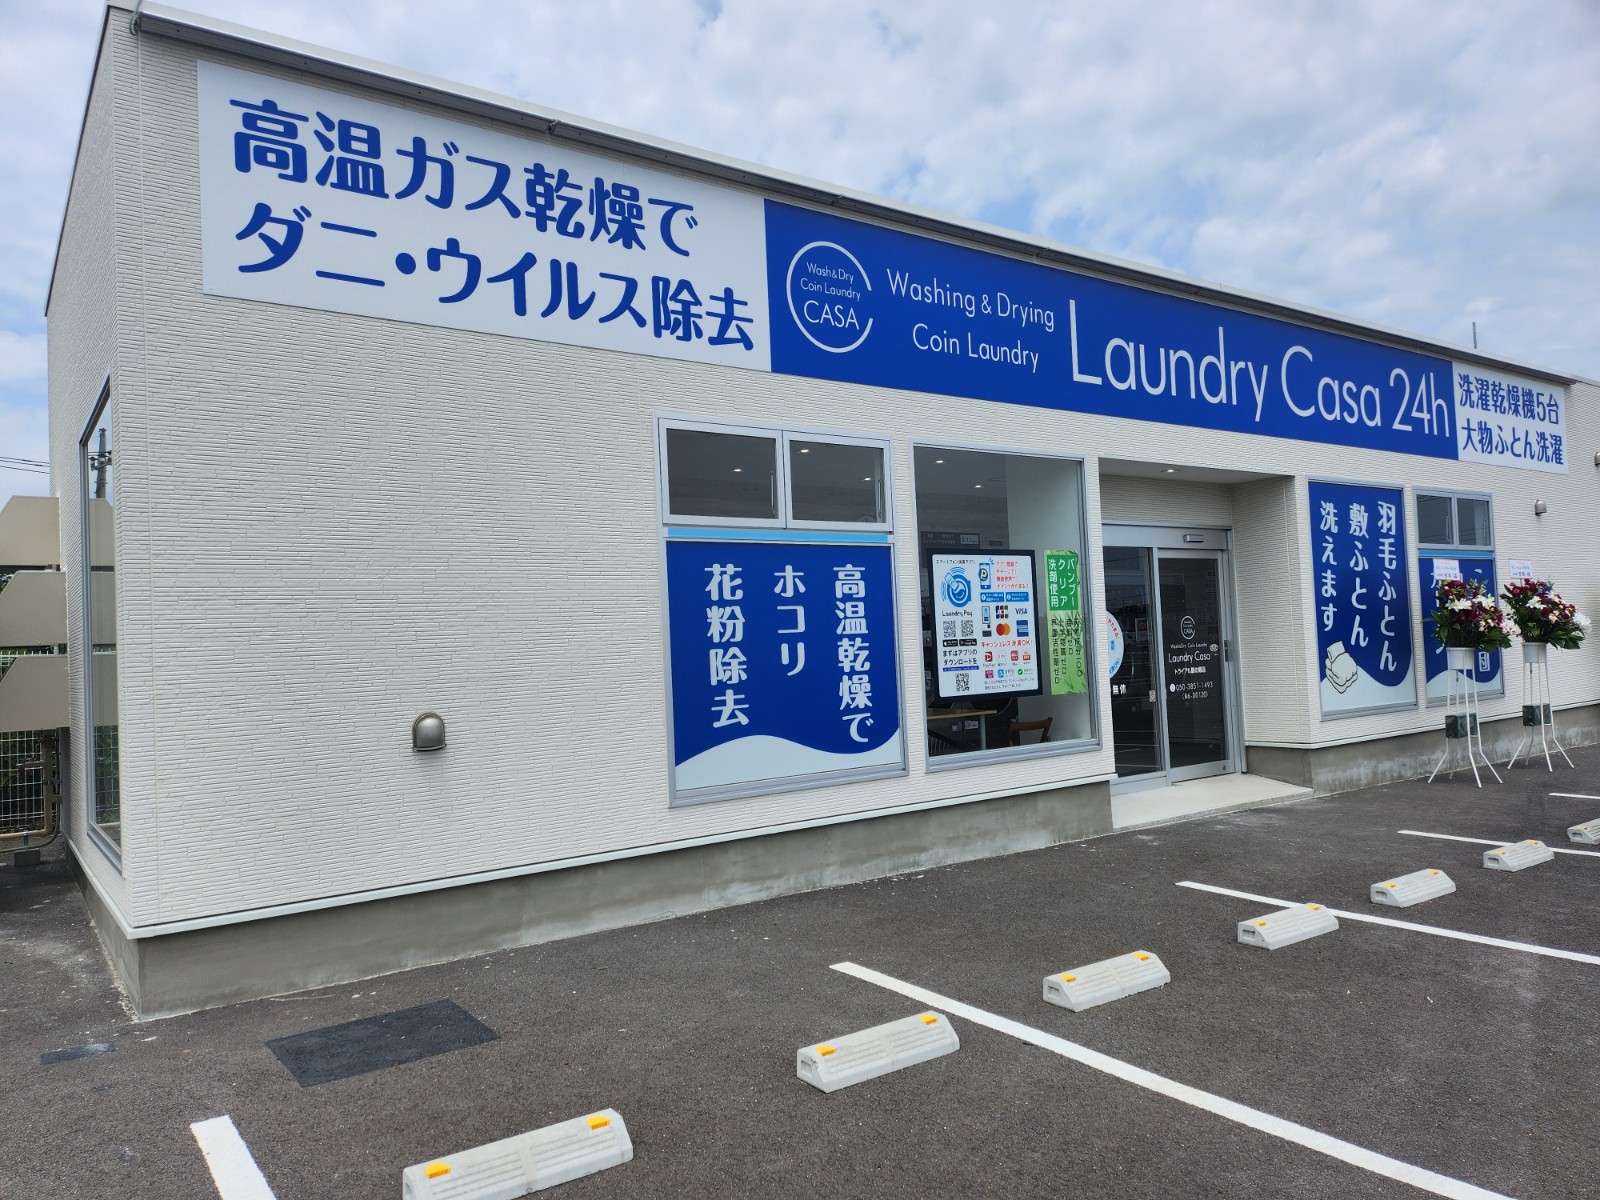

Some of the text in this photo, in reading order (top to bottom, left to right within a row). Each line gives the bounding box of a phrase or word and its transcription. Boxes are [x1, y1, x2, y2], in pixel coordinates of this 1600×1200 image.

[229, 99, 698, 257] 高温ガス乾燥で
[236, 202, 754, 351] ダニ・ウイルス除去
[800, 277, 861, 302] Coin Laundry
[806, 261, 854, 285] Wash&Dry
[803, 300, 860, 330] CASA
[886, 268, 975, 318] Washing
[997, 292, 1055, 332] Drying
[912, 323, 1039, 373] Coin Laundry
[1069, 299, 1450, 438] Laundry Casa 24h
[1458, 373, 1559, 425] 洗濯乾燥機5台
[1461, 418, 1564, 465] 大物ふとん洗濯
[1048, 558, 1059, 608] 洗剤使用
[1058, 558, 1068, 607] クリア
[1067, 558, 1076, 607] バンブー
[1319, 500, 1339, 632] 洗えます
[1349, 503, 1369, 648] 敷ふとん
[1377, 501, 1397, 672] 羽毛ふとん
[704, 563, 750, 729] 花粉除去
[773, 564, 806, 677] ホコリ
[833, 563, 874, 743] 高温乾燥で
[943, 649, 978, 658] まずはアプリの
[943, 657, 978, 666] ダウンロードを
[1168, 650, 1211, 663] Laundry Casa
